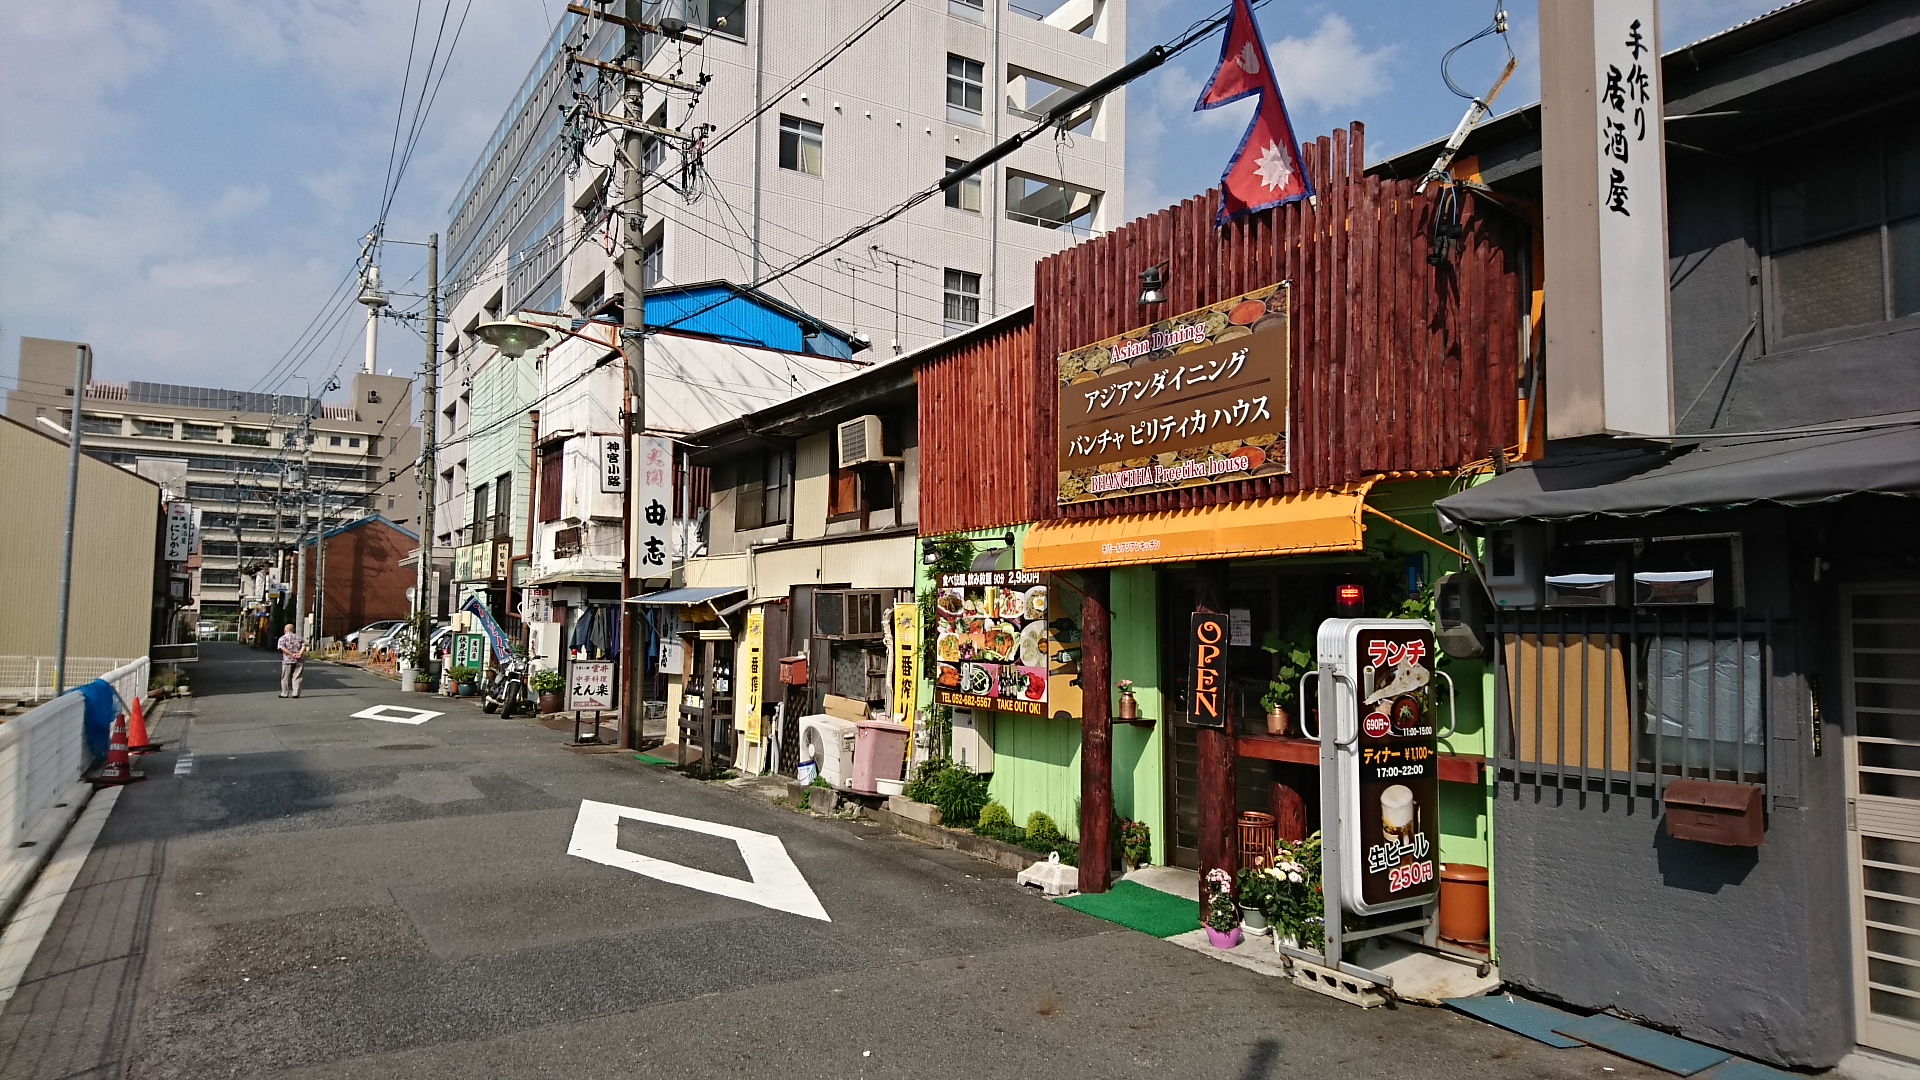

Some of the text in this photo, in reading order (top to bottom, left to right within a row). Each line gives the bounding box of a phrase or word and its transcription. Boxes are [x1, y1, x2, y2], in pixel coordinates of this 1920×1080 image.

[1625, 19, 1650, 141] 手作り
[1602, 64, 1630, 217] 居酒屋
[1110, 322, 1206, 364] Asian Dining
[1084, 347, 1249, 413] アジアンダイニング
[1068, 395, 1271, 458] バンチャ ピリティカ ハウス
[607, 441, 621, 487] 神宮小路
[1091, 455, 1249, 493] BHANCHHA Preetika house
[169, 523, 179, 558] にしかわ
[643, 499, 667, 566] 由志
[1008, 570, 1040, 585] 2,980円
[1194, 621, 1222, 718] OPEN
[1368, 639, 1426, 668] ランチ
[573, 683, 609, 697] えん楽
[576, 675, 607, 683] 中華料理
[901, 644, 912, 722] 一番搾り
[941, 692, 1041, 714] TEL 052-682-5567 TAKE OUT OK!
[1364, 747, 1400, 764] ディナー
[1368, 832, 1429, 874] 生ビール
[1389, 860, 1433, 892] 250円
